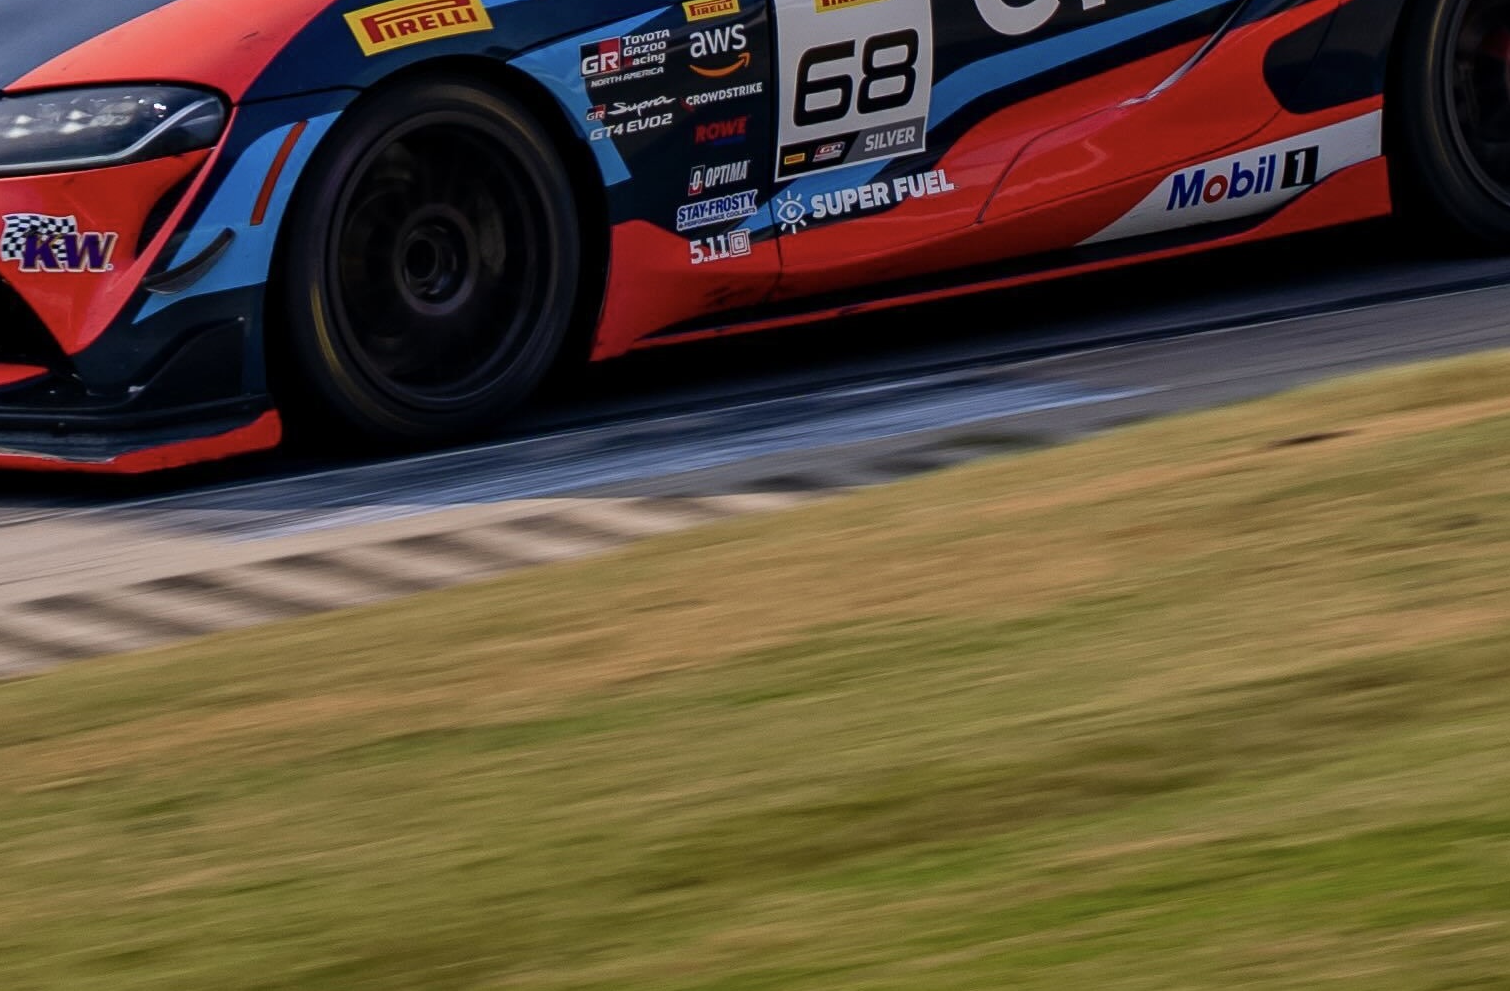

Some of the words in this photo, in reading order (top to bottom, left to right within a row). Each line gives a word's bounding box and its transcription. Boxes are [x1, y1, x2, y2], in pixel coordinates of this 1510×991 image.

[622, 28, 671, 46] TOYOTA
[623, 41, 667, 57] GAZOO
[689, 23, 747, 58] aws
[581, 50, 619, 75] GR
[591, 75, 622, 87] NORTH
[623, 66, 664, 81] AMERICA
[793, 28, 920, 127] 68
[607, 95, 677, 116] Supra
[685, 82, 763, 106] CROWDSTRIKE
[590, 123, 623, 141] GT4
[626, 113, 673, 133] EVO2
[694, 116, 747, 145] ROWE
[864, 126, 916, 152] SILVER
[705, 160, 748, 188] OPTIMA
[1166, 154, 1277, 211] Mobil
[811, 182, 890, 218] SUPER
[893, 169, 955, 201] FUEL
[690, 234, 731, 265] 5.11
